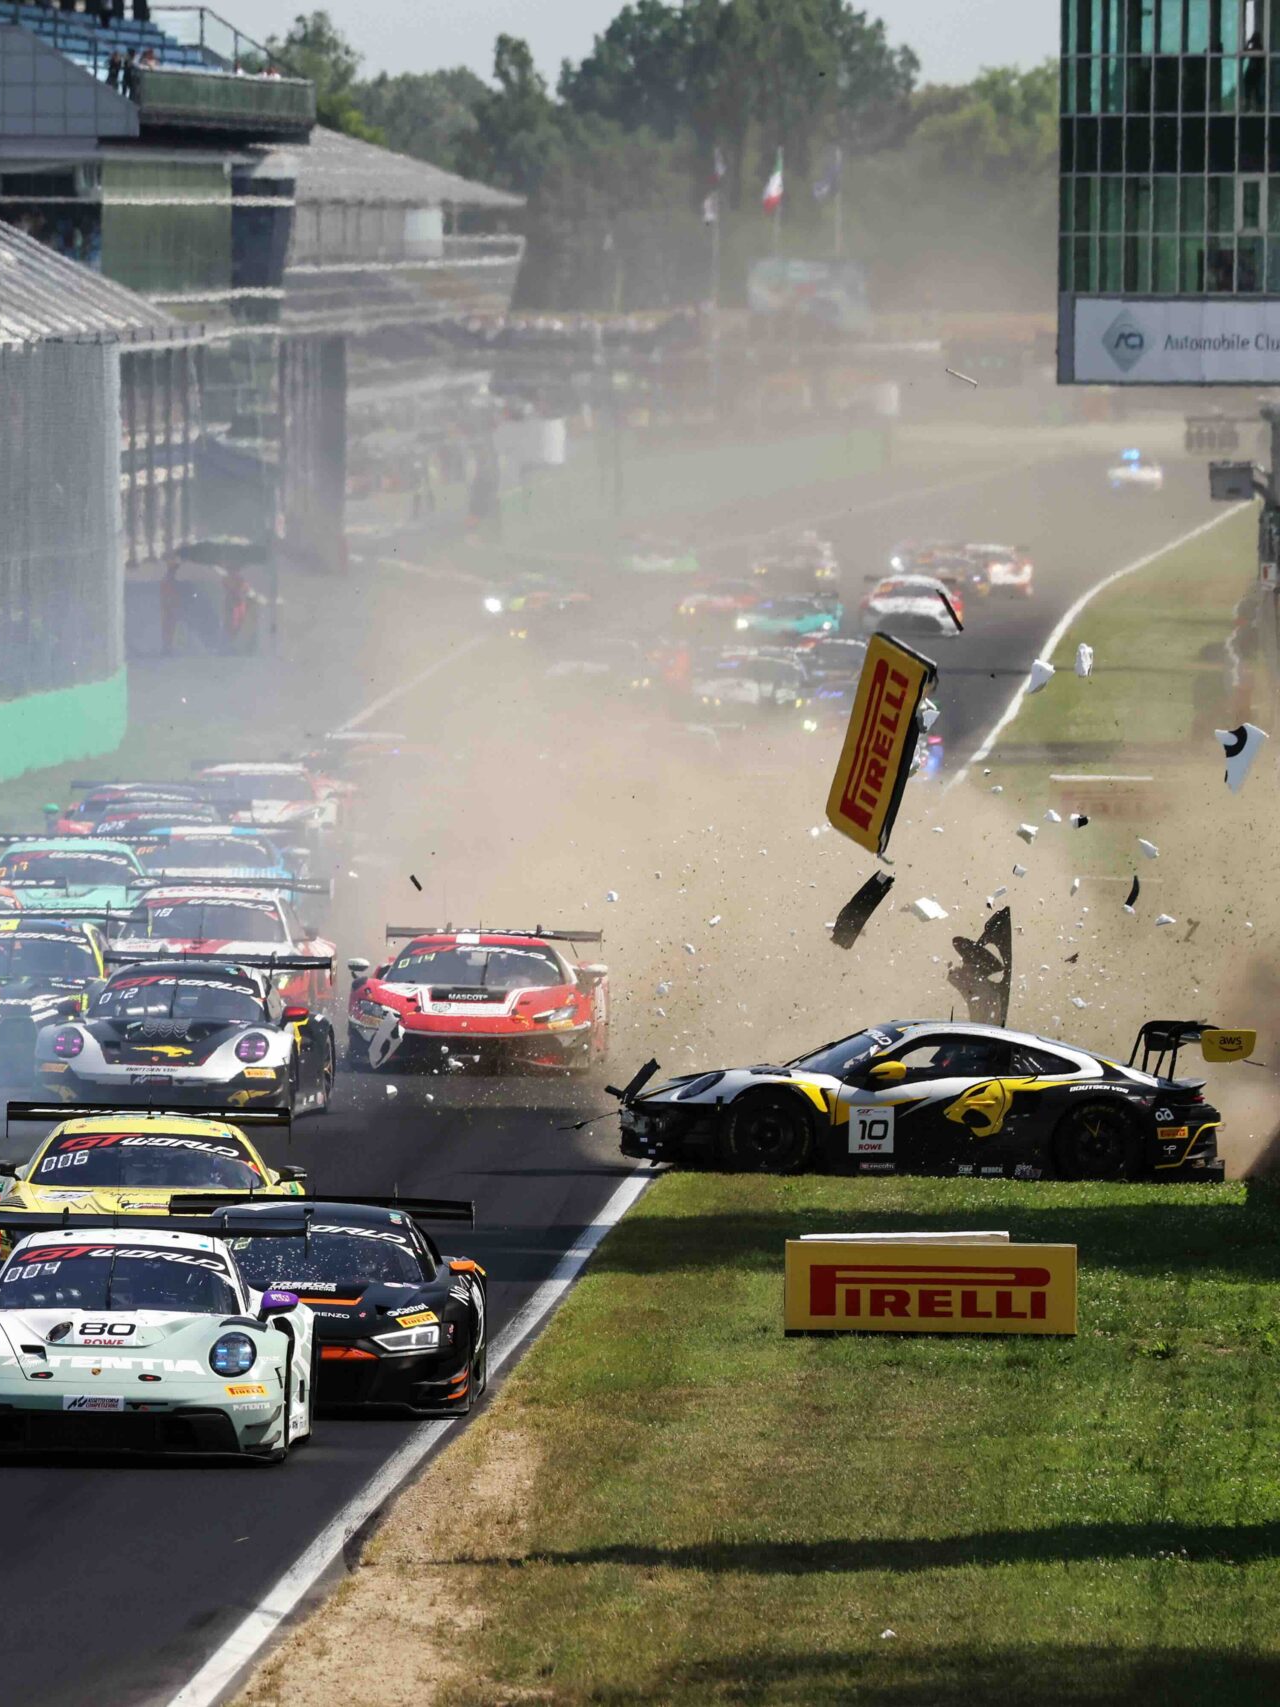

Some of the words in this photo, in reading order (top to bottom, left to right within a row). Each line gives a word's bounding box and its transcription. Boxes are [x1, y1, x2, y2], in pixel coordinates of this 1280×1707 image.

[1164, 334, 1250, 351] Automobile
[1255, 335, 1280, 351] Clu
[839, 657, 910, 832] PIRELLI
[1219, 1035, 1242, 1045] aws
[858, 1119, 889, 1141] 10
[858, 1143, 882, 1151] ROWE
[4, 1261, 62, 1283] 004
[810, 1264, 1051, 1319] PIRELLI
[314, 1311, 350, 1319] RENZO
[397, 1303, 430, 1315] Castrol
[401, 1313, 434, 1326] PIRELLI
[78, 1322, 137, 1336] 80
[45, 1355, 207, 1376] TENTIA
[228, 1384, 265, 1396] PIRELLI
